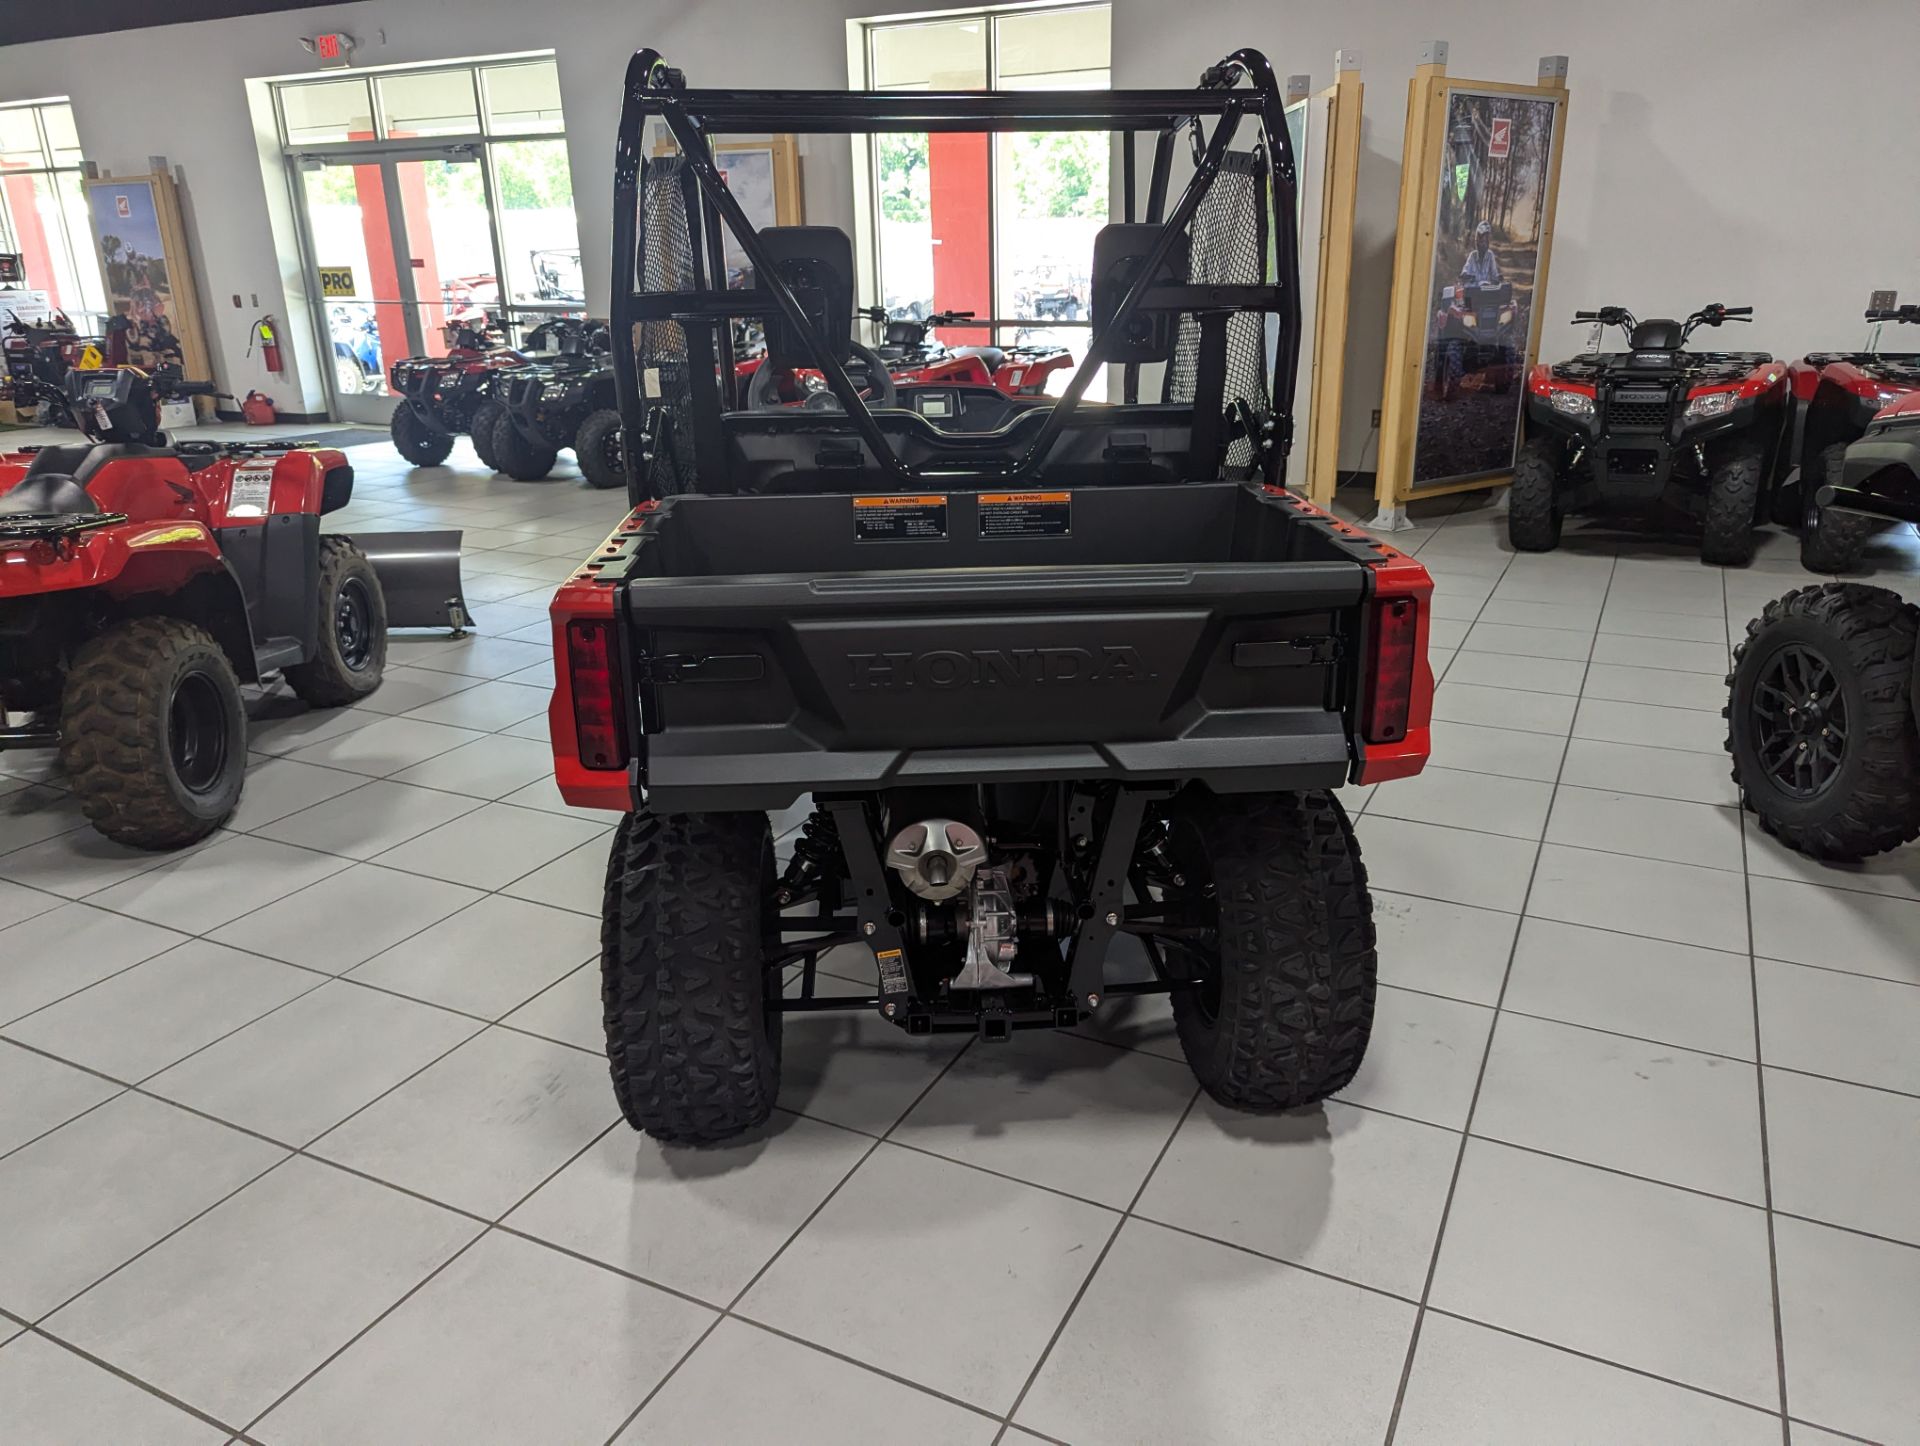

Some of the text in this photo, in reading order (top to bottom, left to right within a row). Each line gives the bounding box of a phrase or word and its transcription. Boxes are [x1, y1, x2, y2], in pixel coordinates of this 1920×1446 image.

[319, 35, 339, 58] EXIT
[321, 272, 353, 290] PRO
[846, 646, 1158, 688] HONDA
